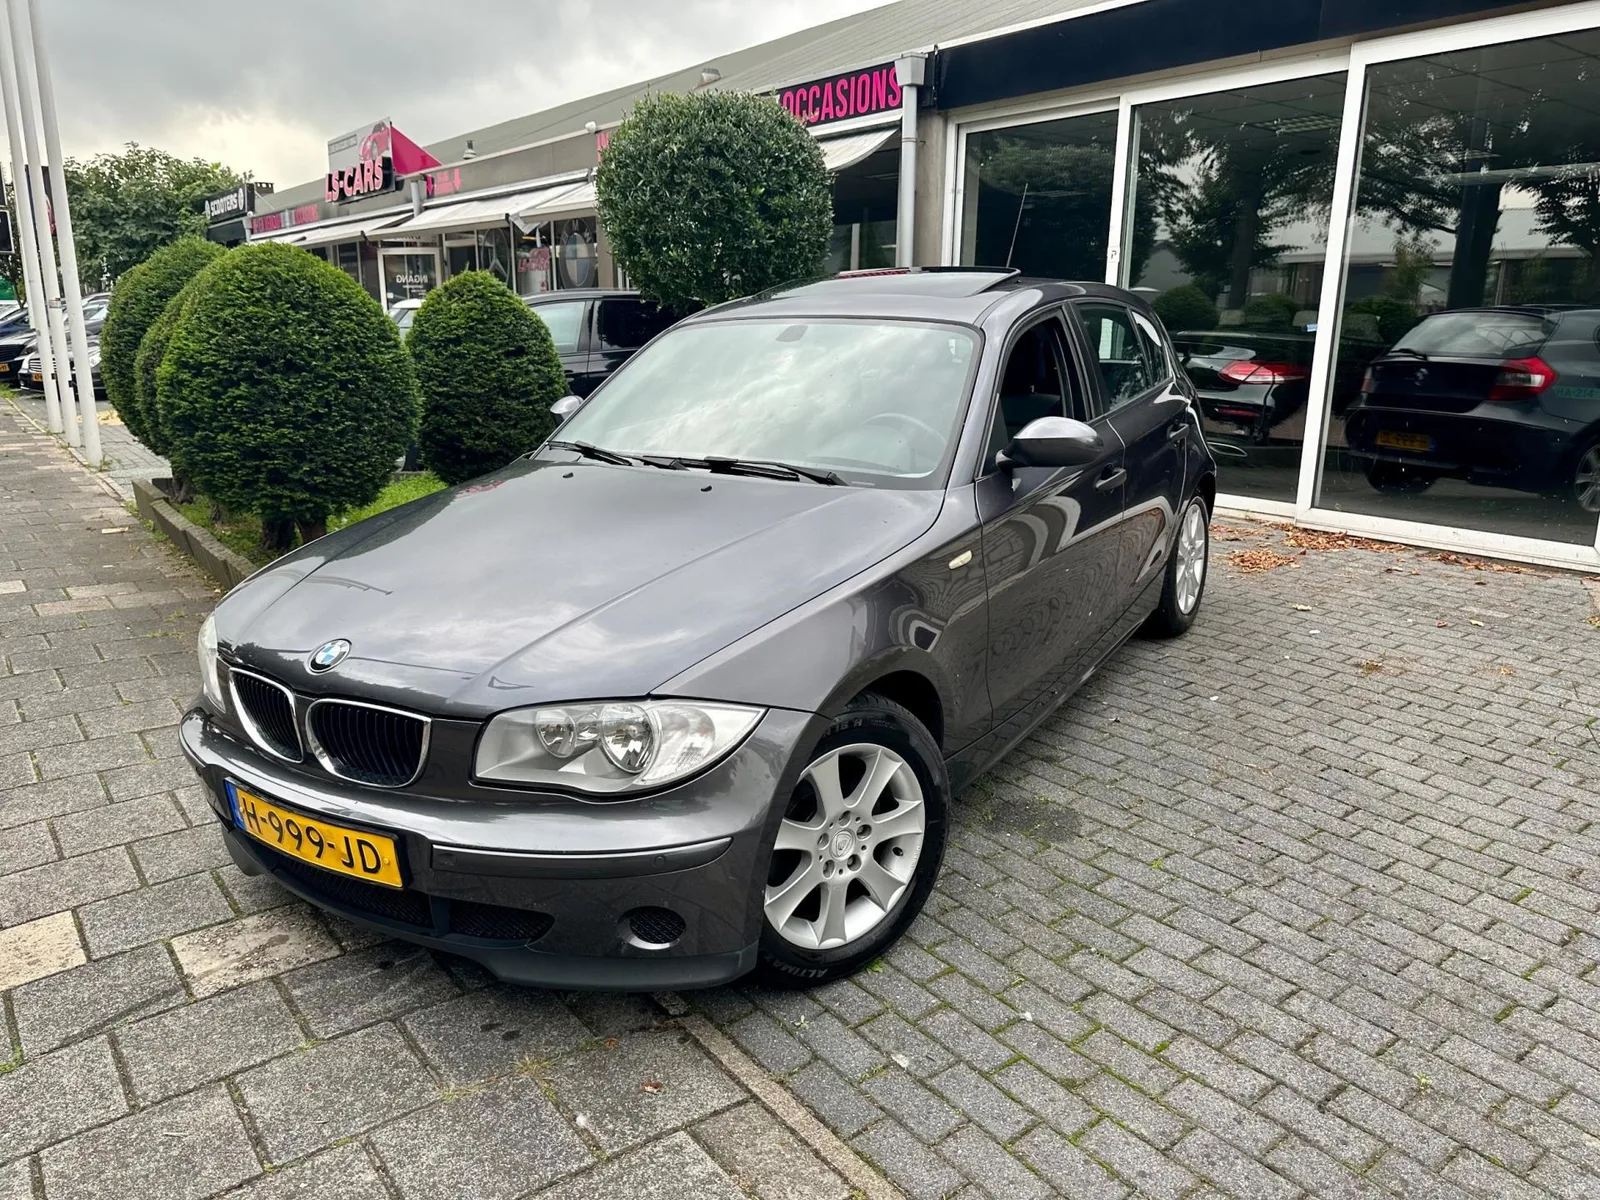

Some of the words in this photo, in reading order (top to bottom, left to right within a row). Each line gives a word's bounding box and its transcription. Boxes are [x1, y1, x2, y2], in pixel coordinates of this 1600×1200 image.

[782, 66, 902, 123] OCCASIONS
[210, 193, 238, 217] SCOOTERS
[325, 156, 383, 203] LS-CARS
[241, 796, 382, 874] H-999-JD
